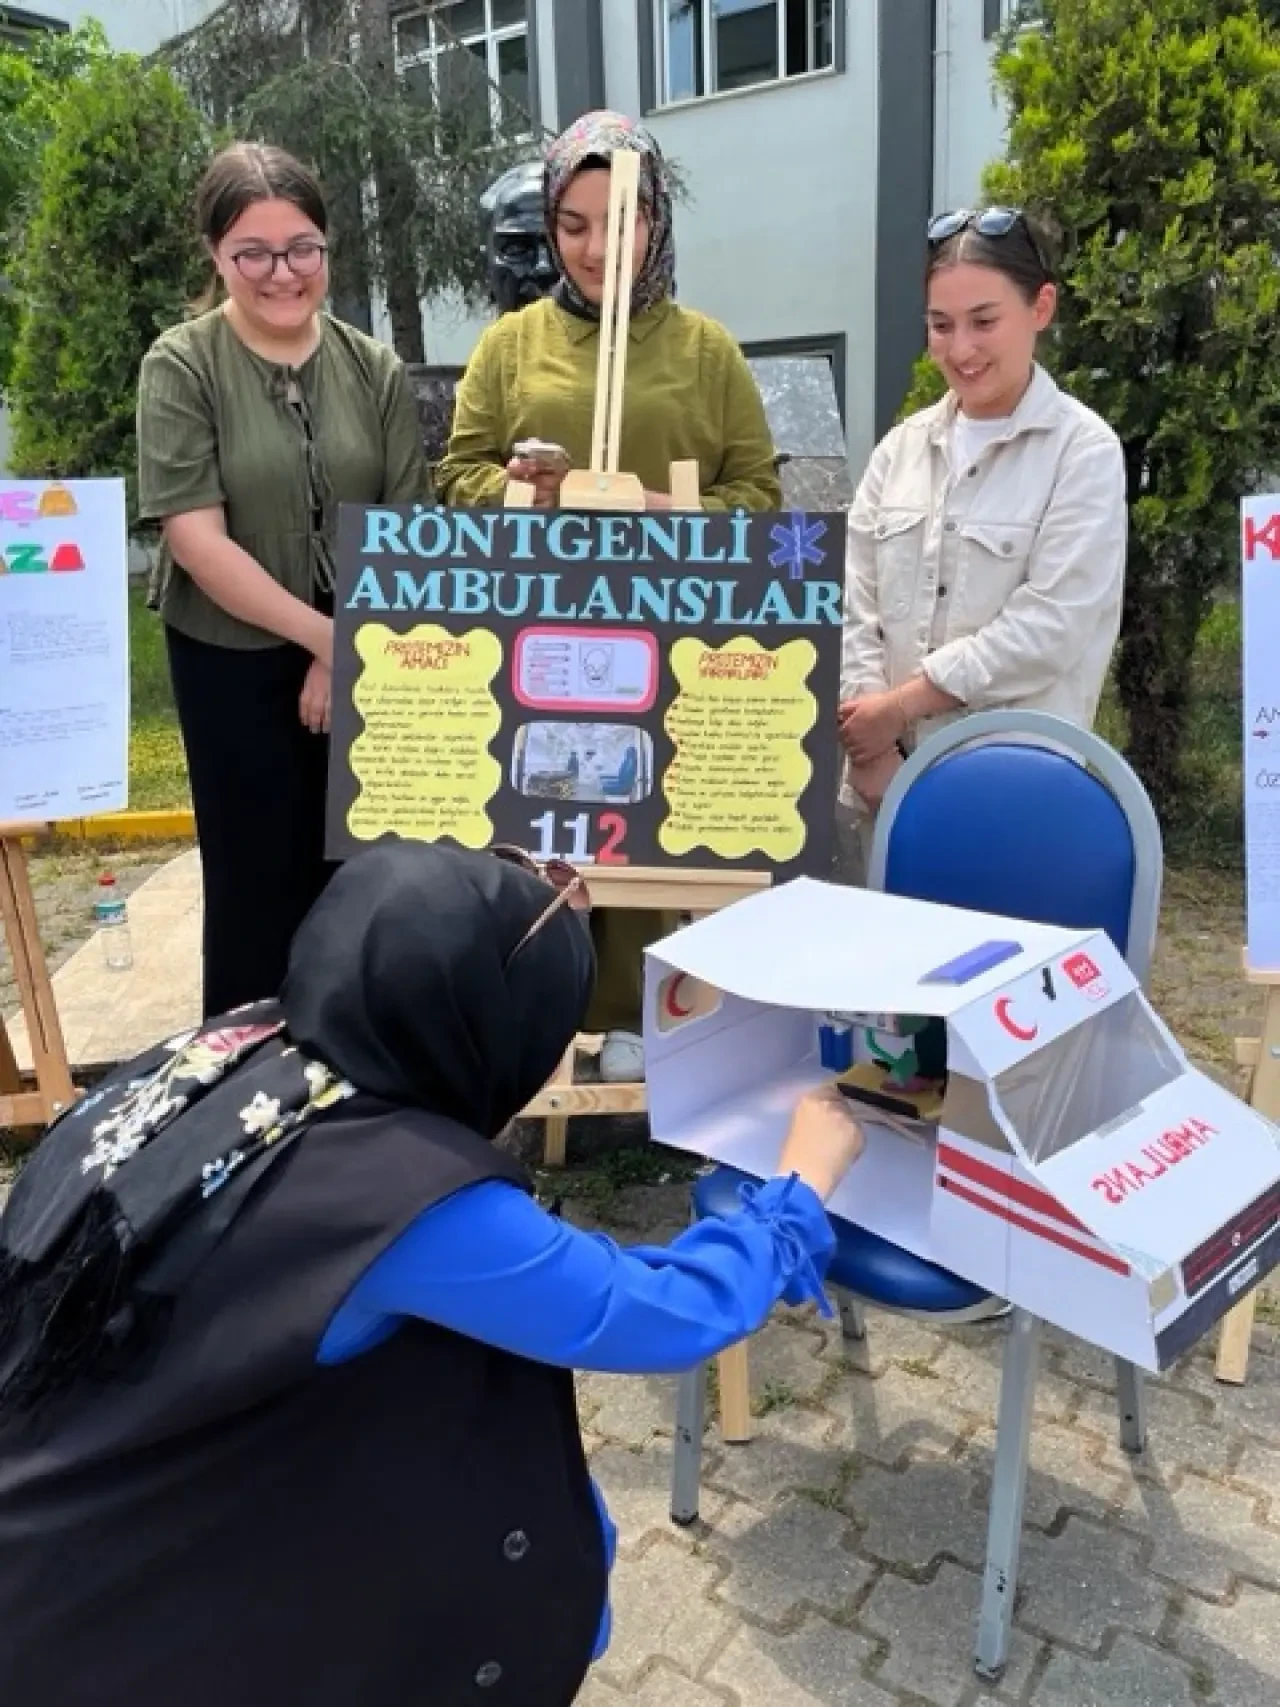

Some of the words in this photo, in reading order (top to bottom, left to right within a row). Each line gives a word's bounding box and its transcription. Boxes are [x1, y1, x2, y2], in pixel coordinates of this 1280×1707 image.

[0, 543, 86, 575] ZA
[360, 503, 753, 564] RÖNTGENLİ
[344, 564, 845, 625] AMBULANSLAR
[529, 809, 630, 865] 112
